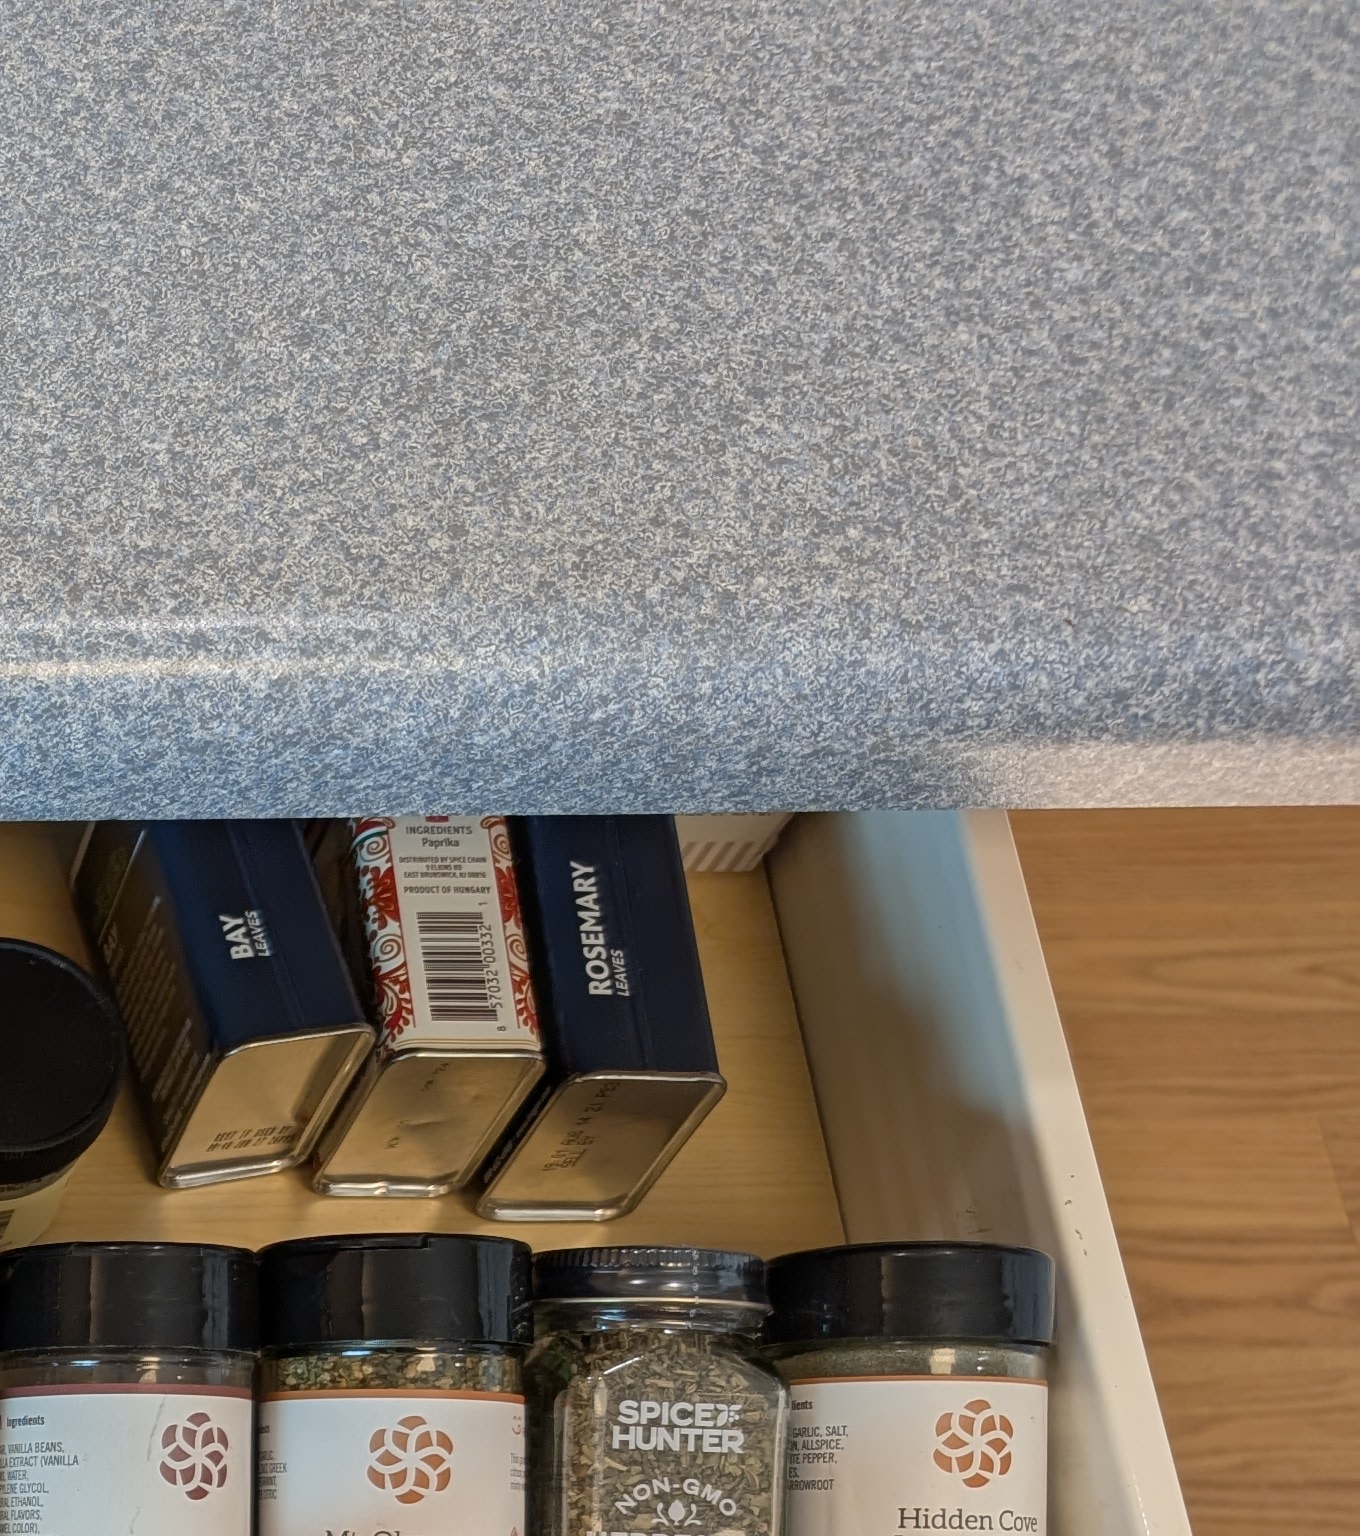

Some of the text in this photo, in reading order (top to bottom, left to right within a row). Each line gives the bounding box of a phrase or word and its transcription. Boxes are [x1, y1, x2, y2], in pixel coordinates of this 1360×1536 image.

[405, 826, 473, 835] INGREDIENTS
[422, 838, 459, 849] Paprika
[403, 886, 439, 894] PRODUCT
[219, 914, 254, 959] BAY
[244, 910, 273, 957] LEAVES
[569, 860, 613, 996] ROSEMARY
[616, 949, 630, 997] LEAVES
[616, 1400, 713, 1428] SPICE
[611, 1426, 745, 1454] HUNTER
[614, 1478, 738, 1516] NON-GMO
[897, 1508, 1038, 1533] Hidden Cove
